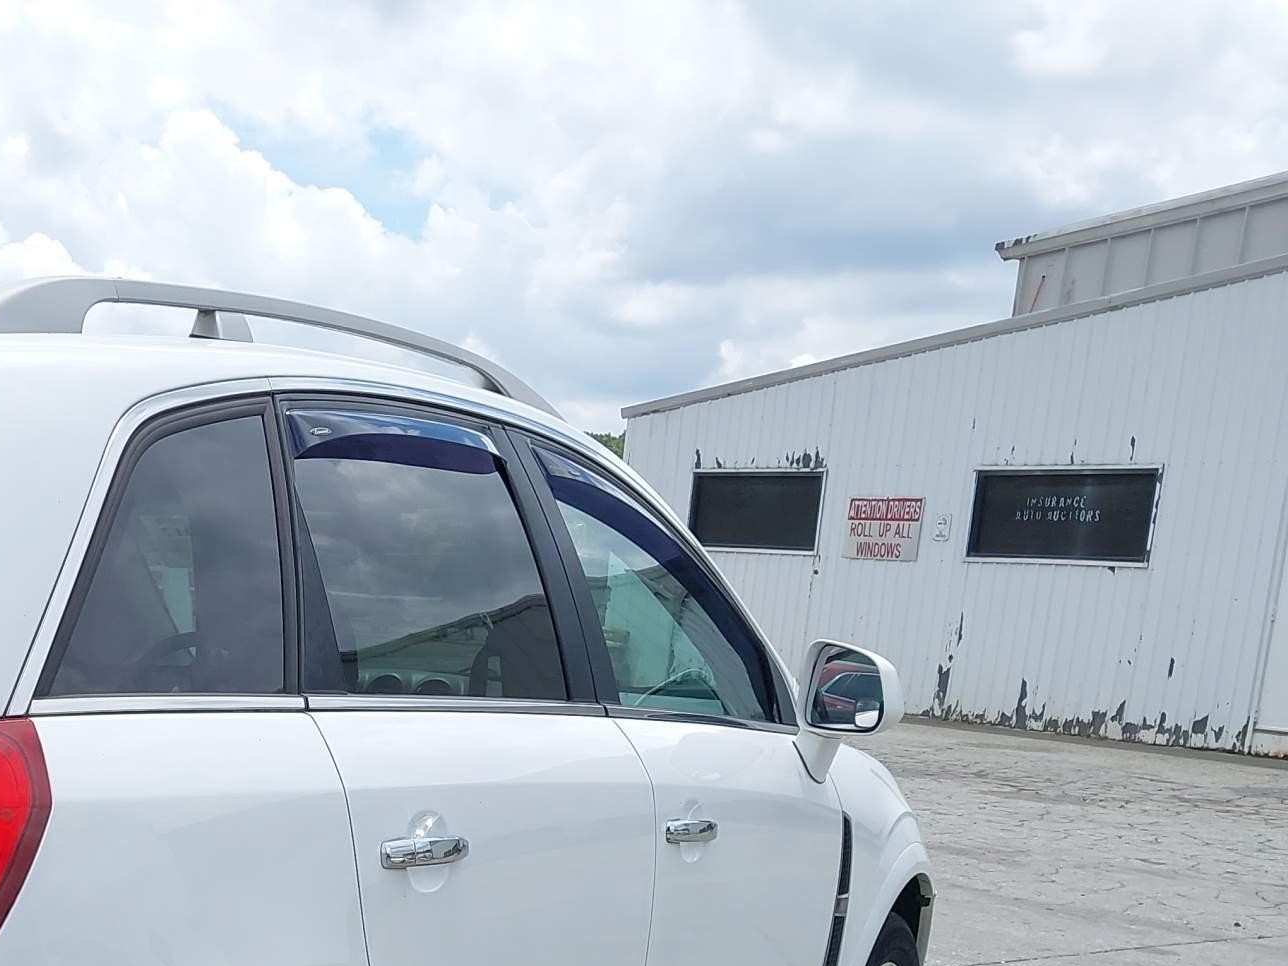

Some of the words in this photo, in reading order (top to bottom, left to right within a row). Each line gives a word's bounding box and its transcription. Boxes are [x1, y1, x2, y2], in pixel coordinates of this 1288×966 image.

[849, 500, 888, 519] ATTENTION
[887, 500, 921, 519] DRIVERS
[1027, 496, 1086, 508] INSURANCE
[850, 522, 872, 538] ROLL
[878, 523, 891, 538] UP
[893, 523, 913, 539] ALL
[856, 541, 902, 559] WINDOWS
